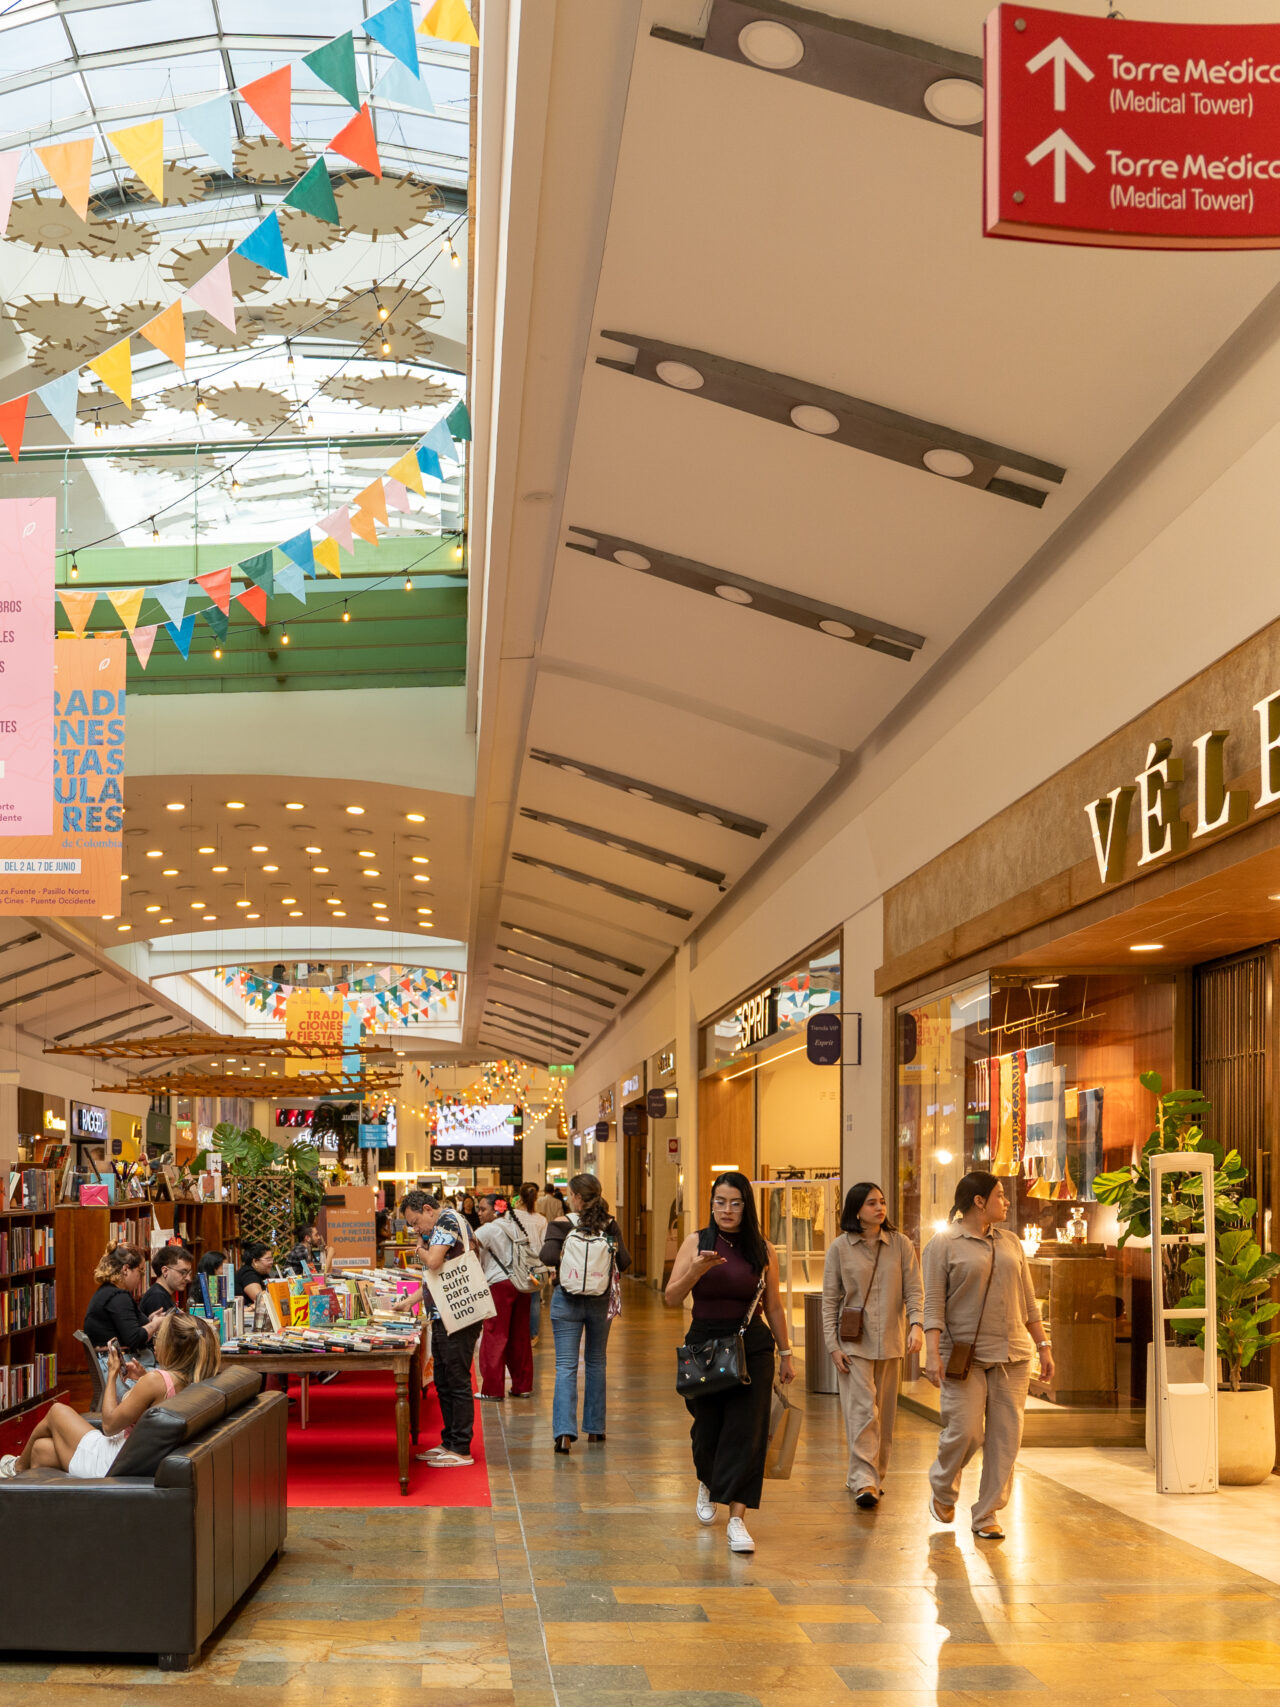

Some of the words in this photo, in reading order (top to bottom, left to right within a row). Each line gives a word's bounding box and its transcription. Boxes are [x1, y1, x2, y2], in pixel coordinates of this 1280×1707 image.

[1107, 54, 1180, 83] Torre
[1110, 88, 1186, 114] (Medical
[1190, 92, 1253, 118] Tower)
[1106, 150, 1179, 179] Torre
[1110, 184, 1186, 210] (Medical
[1191, 188, 1254, 214] Tower)
[63, 806, 123, 832] RES
[61, 839, 74, 848] de
[75, 838, 123, 848] Colombia
[4, 861, 18, 872] DEL
[20, 861, 25, 871] 2
[26, 861, 35, 871] AL
[37, 861, 42, 871] 7
[44, 861, 53, 871] DE
[55, 861, 76, 871] JUNIO
[307, 1011, 343, 1020] TRADI
[735, 987, 771, 1051] ESPRIT
[299, 1021, 343, 1031] CIONES
[297, 1031, 343, 1040] FIESTAS
[433, 1149, 468, 1162] SBQ
[439, 1264, 468, 1282] Tanto
[442, 1274, 470, 1292] sufrir
[446, 1286, 470, 1303] para
[449, 1289, 490, 1311] morirse
[453, 1306, 475, 1320] uno
